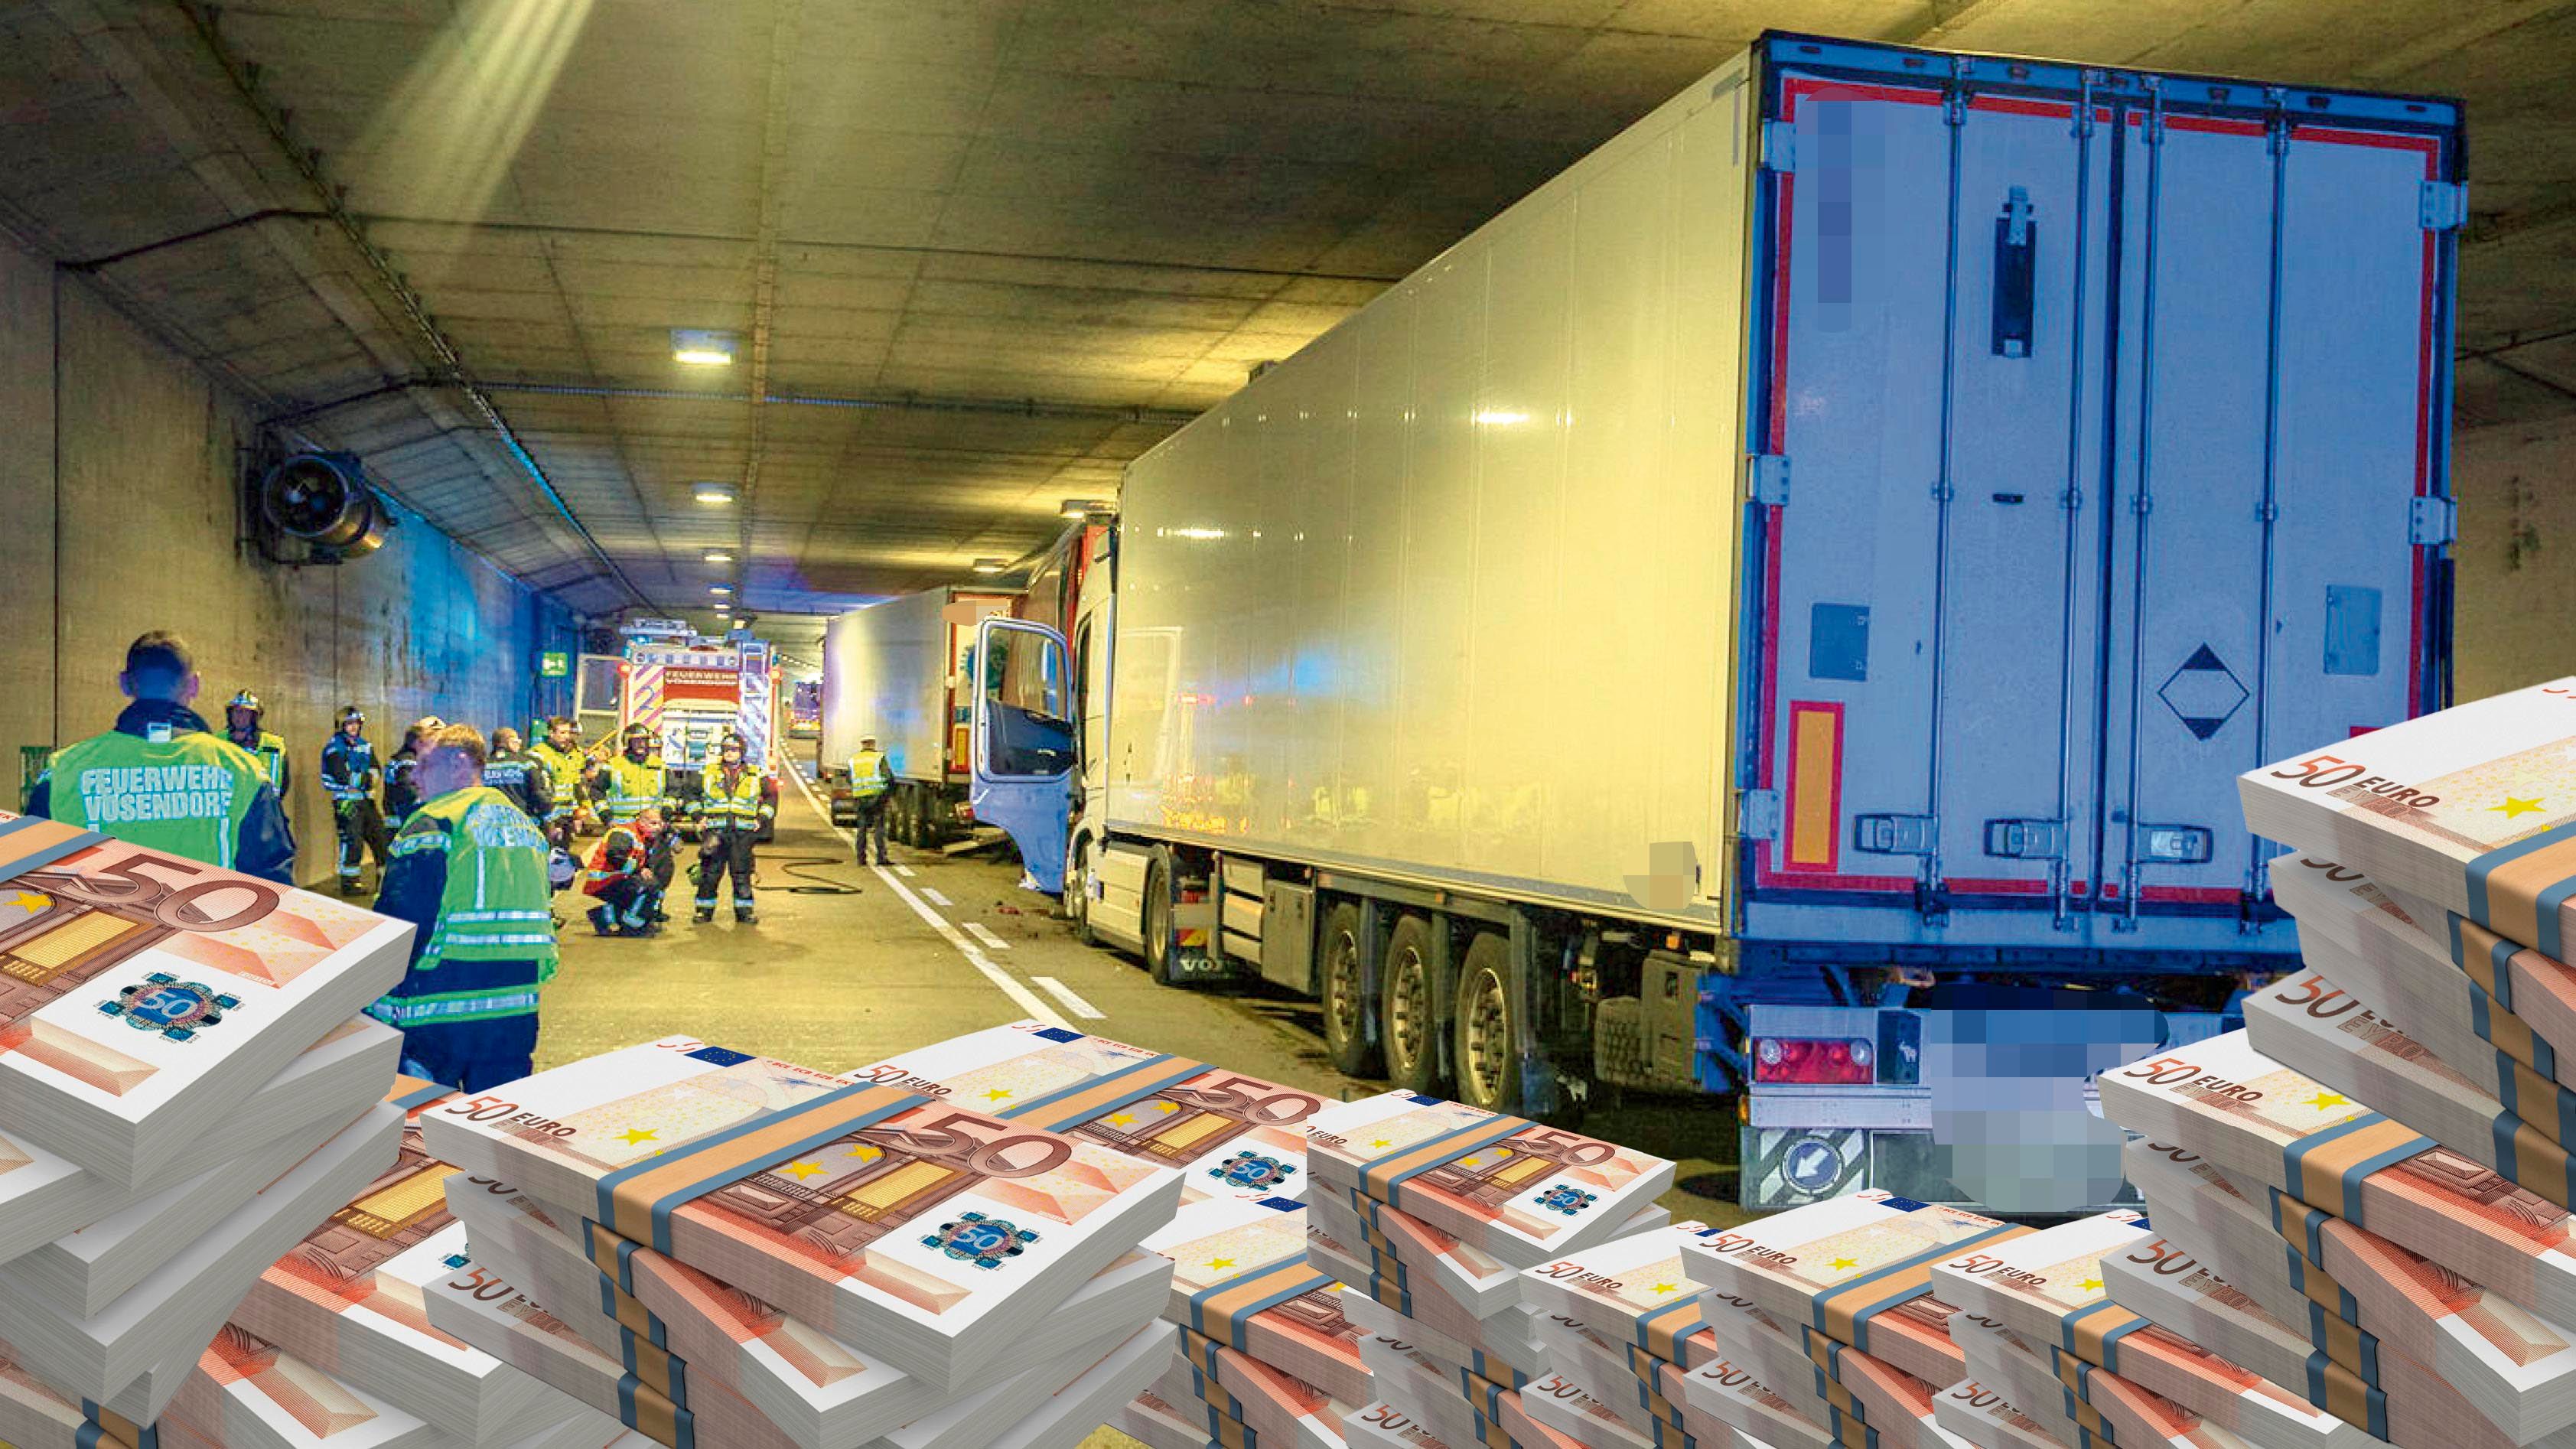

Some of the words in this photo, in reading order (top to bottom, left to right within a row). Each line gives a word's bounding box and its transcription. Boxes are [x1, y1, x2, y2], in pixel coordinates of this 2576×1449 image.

[82, 765, 233, 794] FEUERWEHR
[2270, 755, 2366, 787] 50
[2351, 776, 2440, 808] EURO
[57, 853, 280, 933] 50
[136, 990, 198, 1019] 50
[2275, 975, 2360, 1018] 50
[853, 1065, 910, 1083] 50
[901, 1076, 953, 1096] EURO
[2123, 1058, 2202, 1085] 50
[2191, 1075, 2264, 1102] EURO
[445, 1096, 519, 1121] 50
[509, 1112, 577, 1137] EURO
[1184, 1077, 1321, 1126] 50
[886, 1113, 1072, 1178] 50
[1311, 1131, 1348, 1144] EURO
[1516, 1131, 1615, 1167] 50
[1232, 1162, 1270, 1179] 50
[953, 1226, 1006, 1251] 50
[1698, 1234, 1754, 1252] 50
[1747, 1245, 1797, 1264] EURO
[1948, 1255, 2004, 1273] 50
[1996, 1266, 2047, 1285] EURO
[2126, 1239, 2197, 1275] 50
[448, 1267, 515, 1301] 50
[1535, 1262, 1584, 1278] 50
[1578, 1272, 1623, 1289] EURO
[1537, 1376, 1581, 1399] 50
[1702, 1361, 1751, 1386] 50
[1951, 1382, 2001, 1407] 50
[1361, 1404, 1411, 1430] 50
